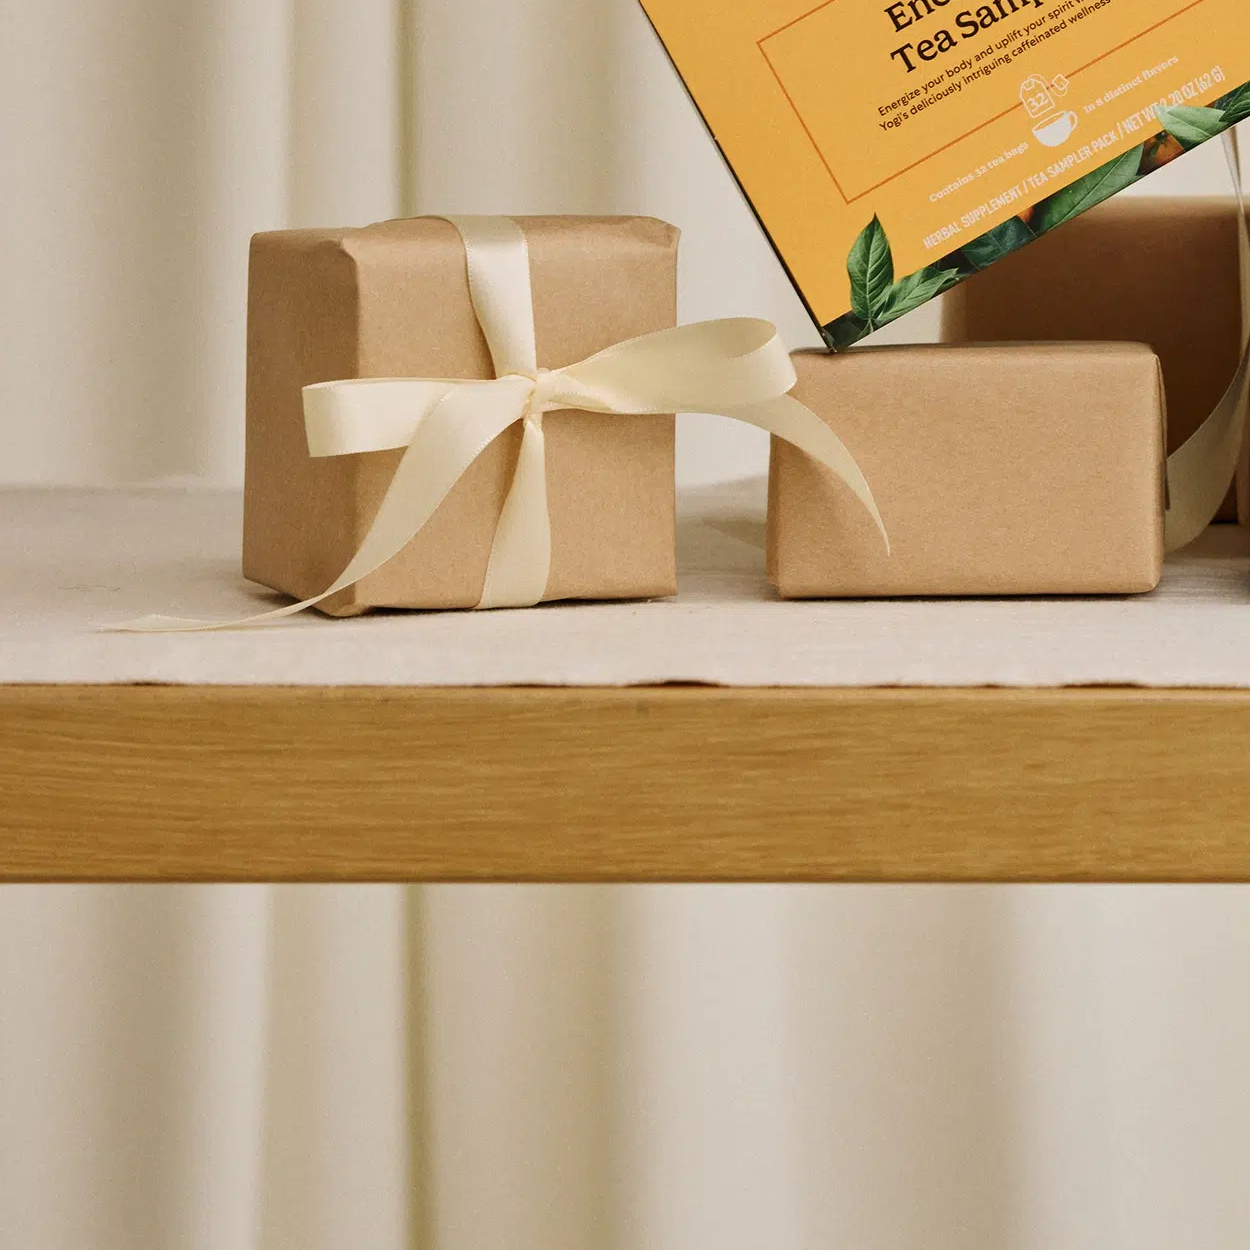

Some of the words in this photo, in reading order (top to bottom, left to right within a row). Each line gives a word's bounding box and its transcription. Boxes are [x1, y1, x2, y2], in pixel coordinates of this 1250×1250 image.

[877, 88, 921, 117] Energize
[921, 74, 945, 95] your
[945, 58, 973, 78] body
[974, 44, 995, 62] and
[994, 29, 1023, 50] uplift
[1023, 16, 1046, 36] your
[1047, 0, 1075, 20] spirit
[879, 112, 910, 131] Yogi's
[909, 81, 962, 116] deliciously
[961, 53, 1013, 85] intriguing
[1011, 19, 1068, 57] caffeinated
[889, 29, 958, 74] Tea
[1103, 75, 1144, 103] distinct
[1141, 56, 1179, 80] flavors
[1026, 92, 1049, 113] 32
[922, 221, 962, 250] HERBAL
[960, 185, 1022, 228] SUPPLEMENT
[1027, 171, 1049, 188] TEA
[1046, 145, 1093, 178] SAMPLER
[1091, 129, 1119, 152] PACK
[1122, 112, 1144, 134] NET
[1180, 81, 1199, 100] OZ
[928, 173, 975, 202] Contains
[987, 156, 1006, 169] tea
[1003, 142, 1029, 160] bags
